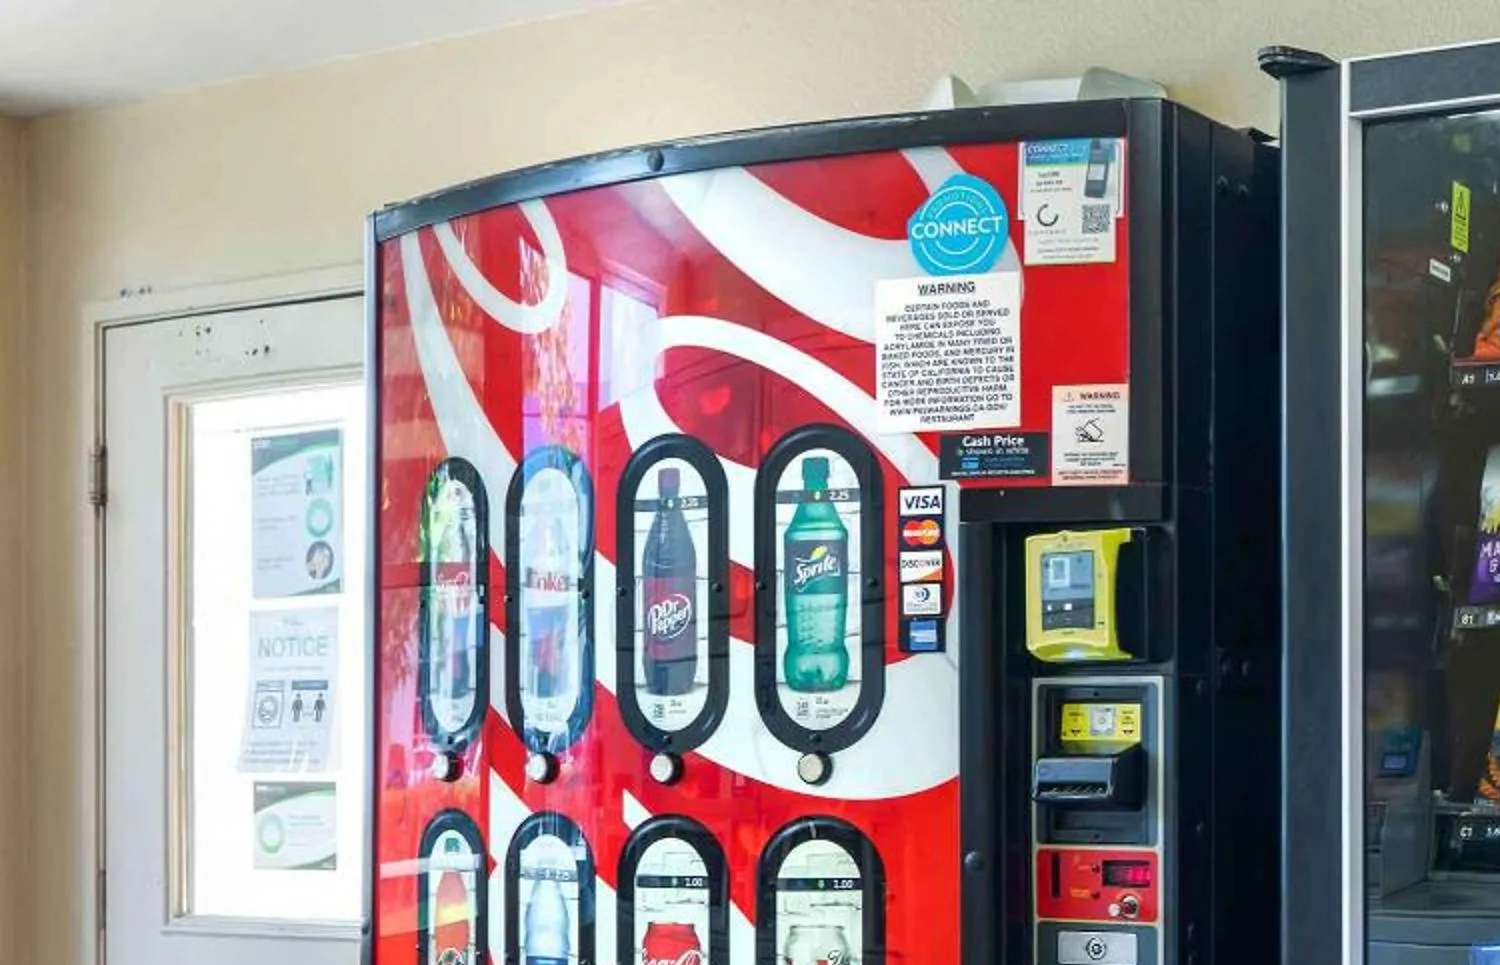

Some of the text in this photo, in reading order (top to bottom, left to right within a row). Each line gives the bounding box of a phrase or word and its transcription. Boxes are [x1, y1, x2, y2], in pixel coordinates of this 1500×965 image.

[912, 216, 1002, 240] CONNECT
[918, 281, 975, 296] WARNING
[1080, 392, 1121, 401] WARNING
[962, 435, 1025, 447] Cash Price
[905, 496, 940, 510] VISA
[794, 554, 839, 586] Sprite
[257, 636, 330, 658] NOTICE
[833, 880, 854, 890] 1.00
